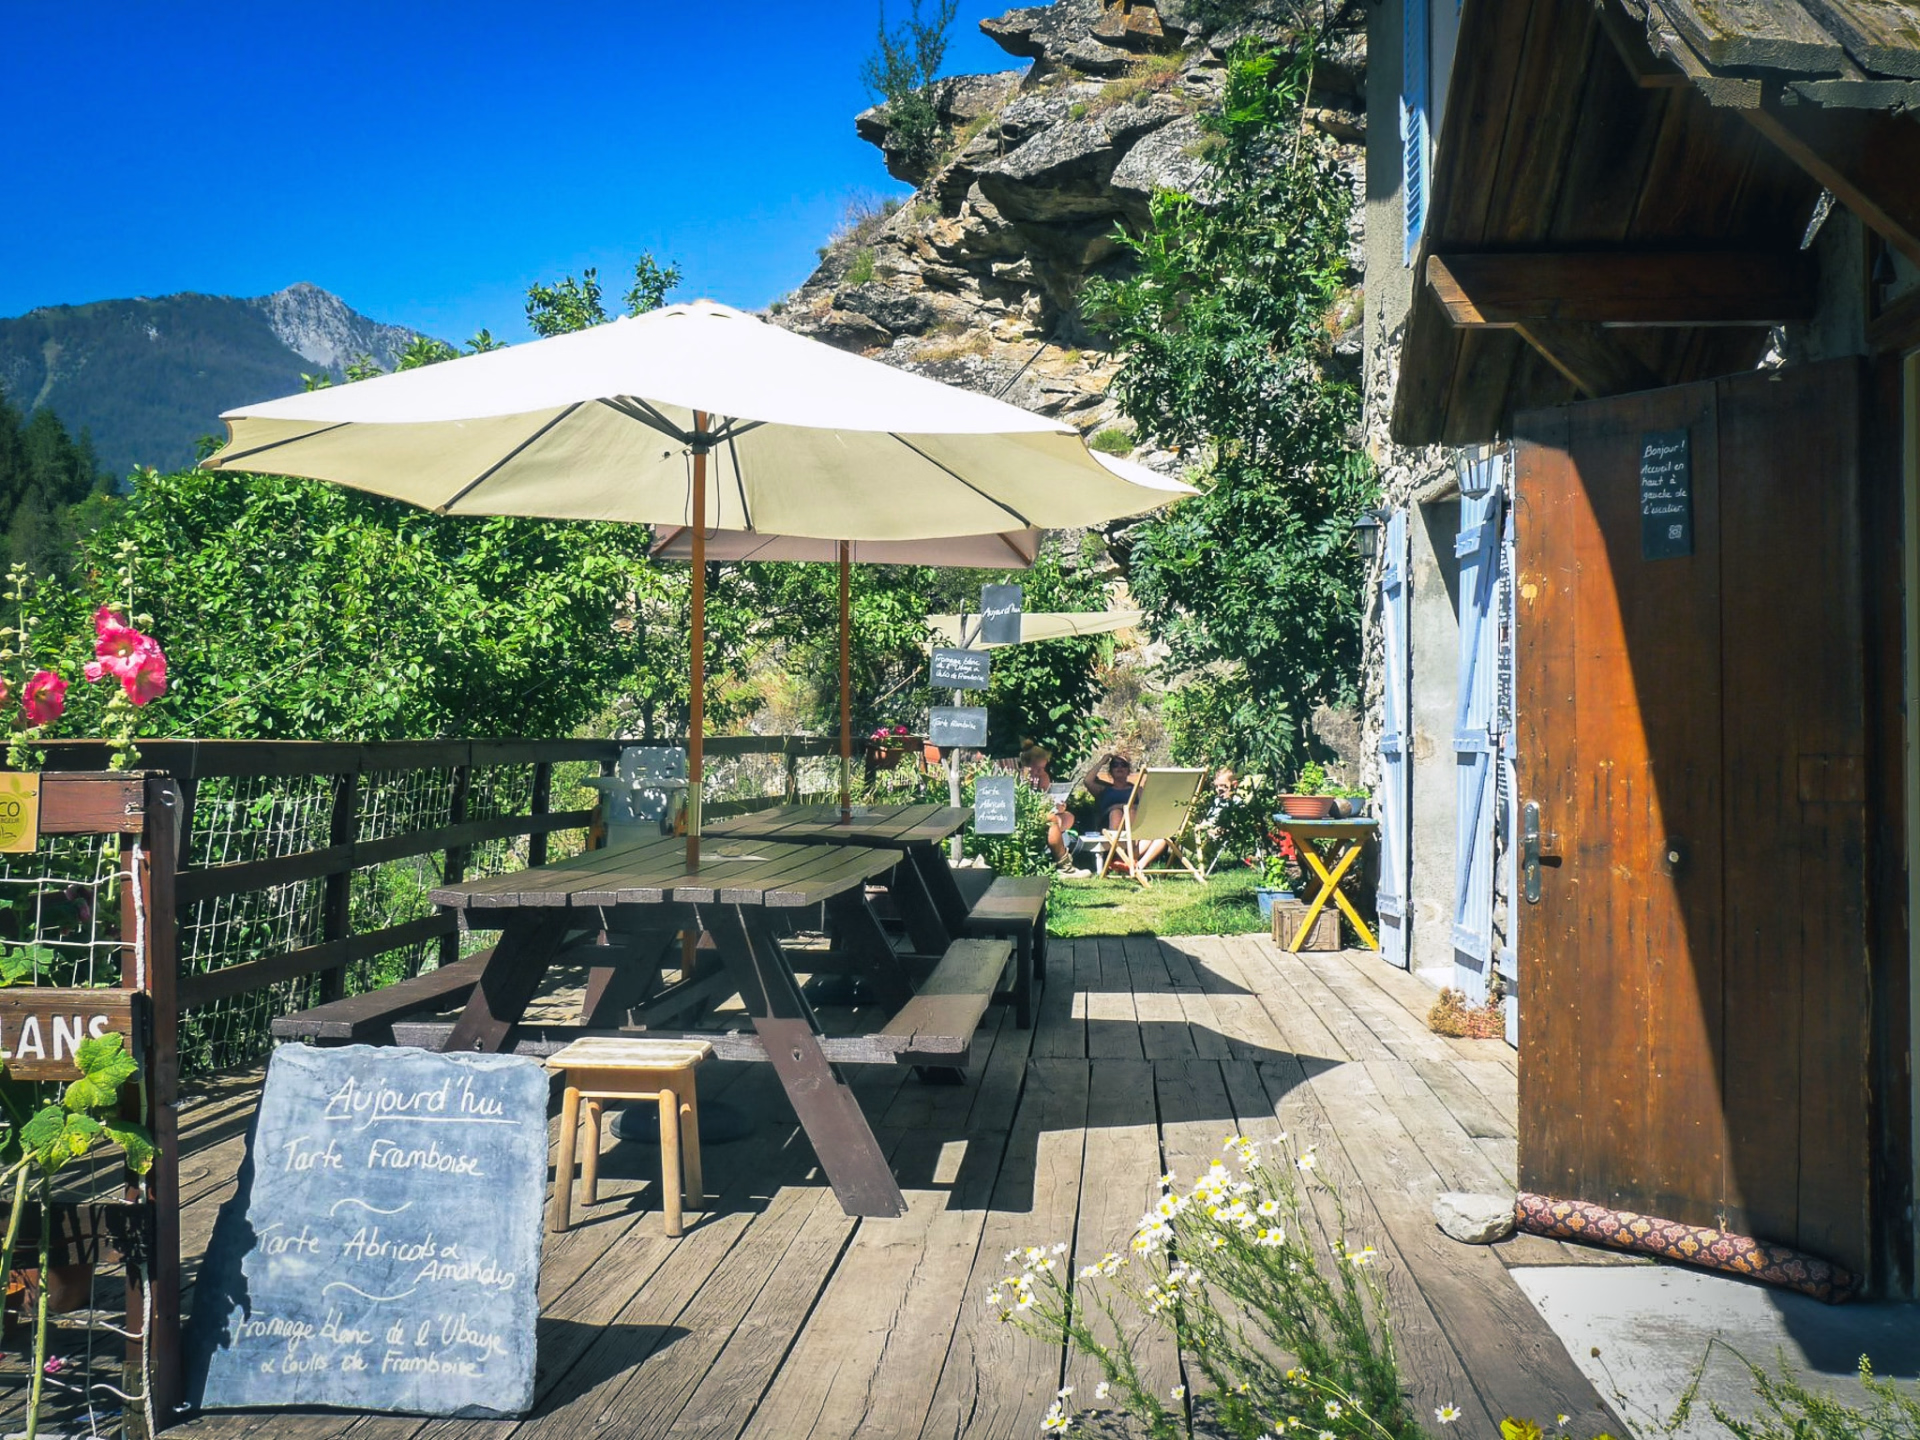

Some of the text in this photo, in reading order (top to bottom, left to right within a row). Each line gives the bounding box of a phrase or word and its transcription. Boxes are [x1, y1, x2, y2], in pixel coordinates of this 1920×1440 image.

[1643, 444, 1679, 460] Bonjour
[1641, 462, 1684, 474] Accueil en
[1641, 476, 1663, 486] haut
[1641, 488, 1687, 503] gauche de
[980, 786, 999, 795] Tarte
[325, 1076, 504, 1131] Aujourd'hui
[283, 1136, 485, 1176] Tarte Framboise
[256, 1223, 320, 1254] Tarte
[344, 1226, 436, 1261] Abricots
[233, 1311, 316, 1351] Fromage
[319, 1307, 373, 1344] blanc
[386, 1319, 405, 1345] de
[281, 1353, 328, 1375] Coulis
[341, 1350, 368, 1371] de
[381, 1350, 484, 1377] Framboise
